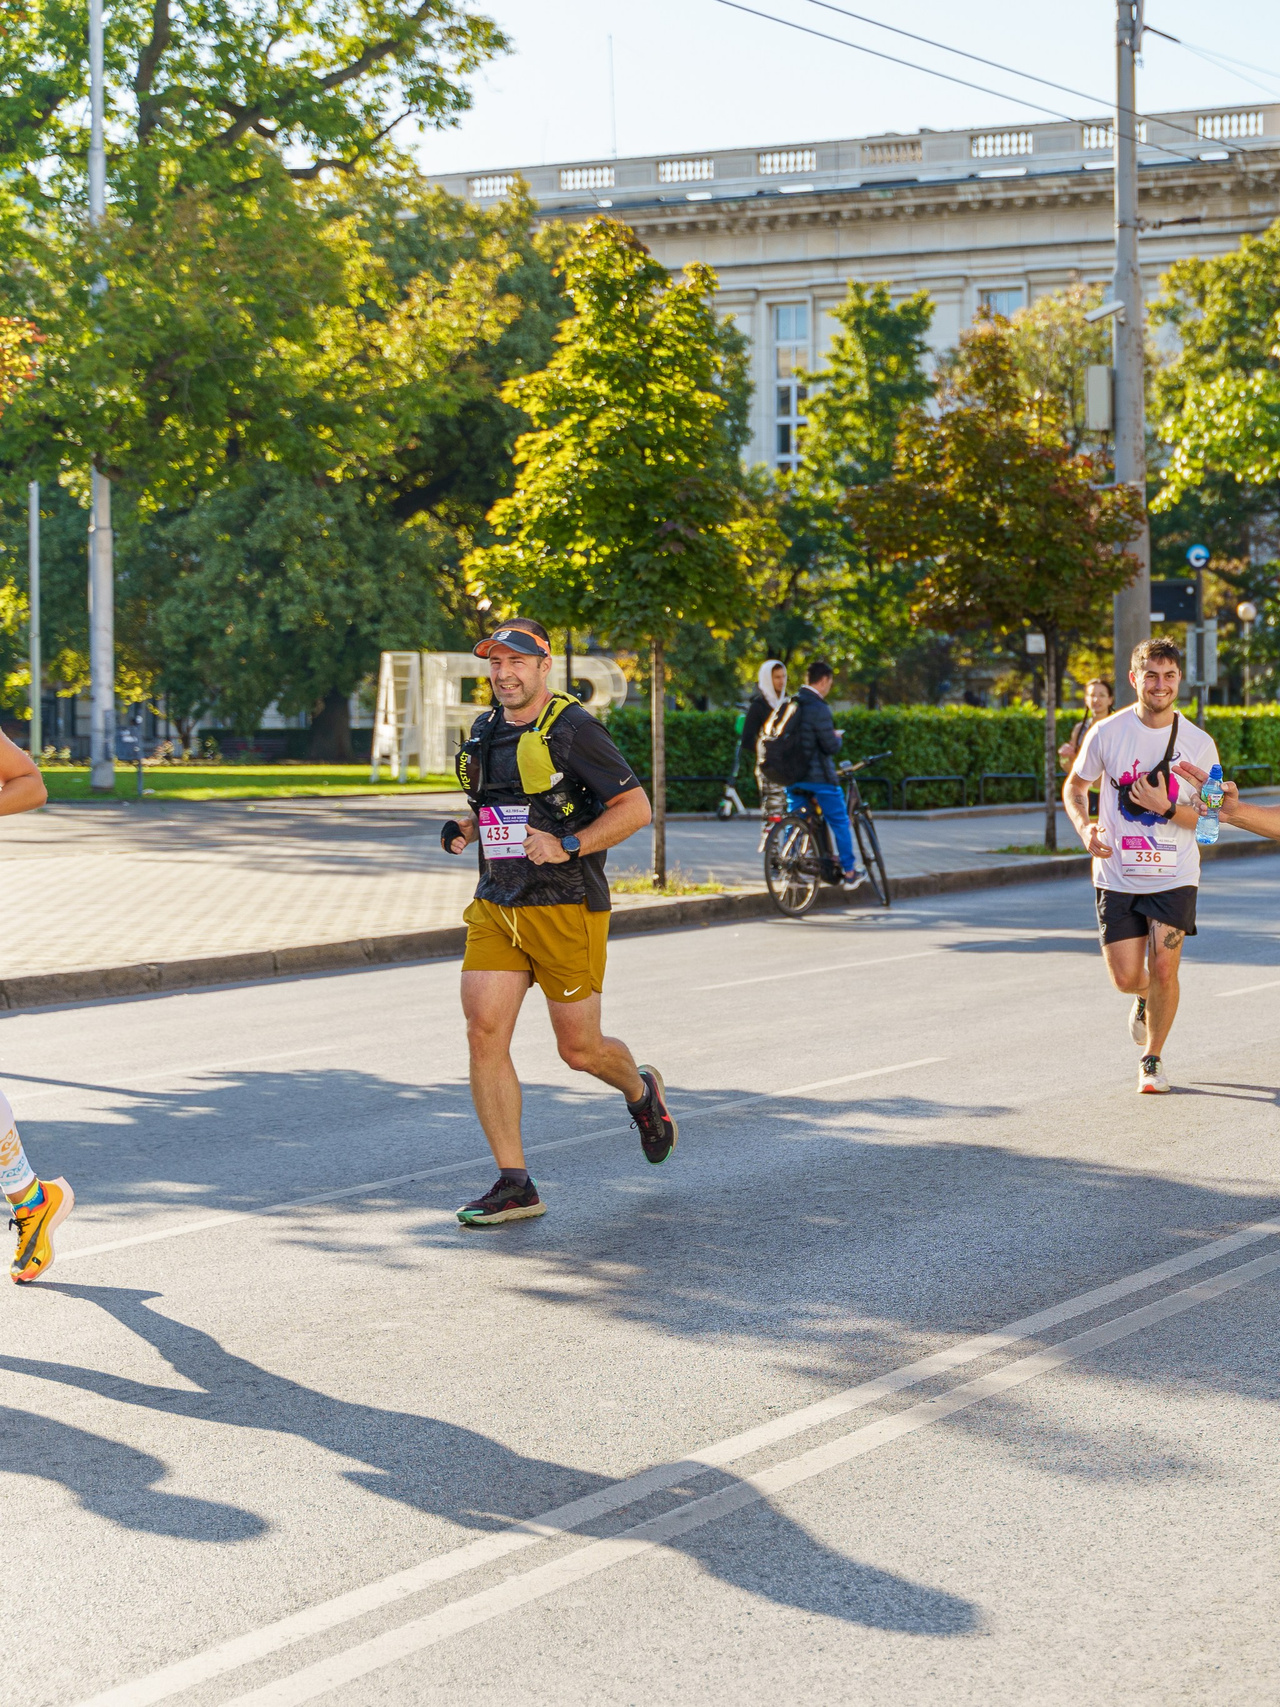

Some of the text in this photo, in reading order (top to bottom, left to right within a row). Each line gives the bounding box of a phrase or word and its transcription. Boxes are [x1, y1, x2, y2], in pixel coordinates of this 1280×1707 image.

[459, 751, 471, 790] INSTINCT
[487, 826, 509, 841] 433
[1136, 852, 1161, 862] 336
